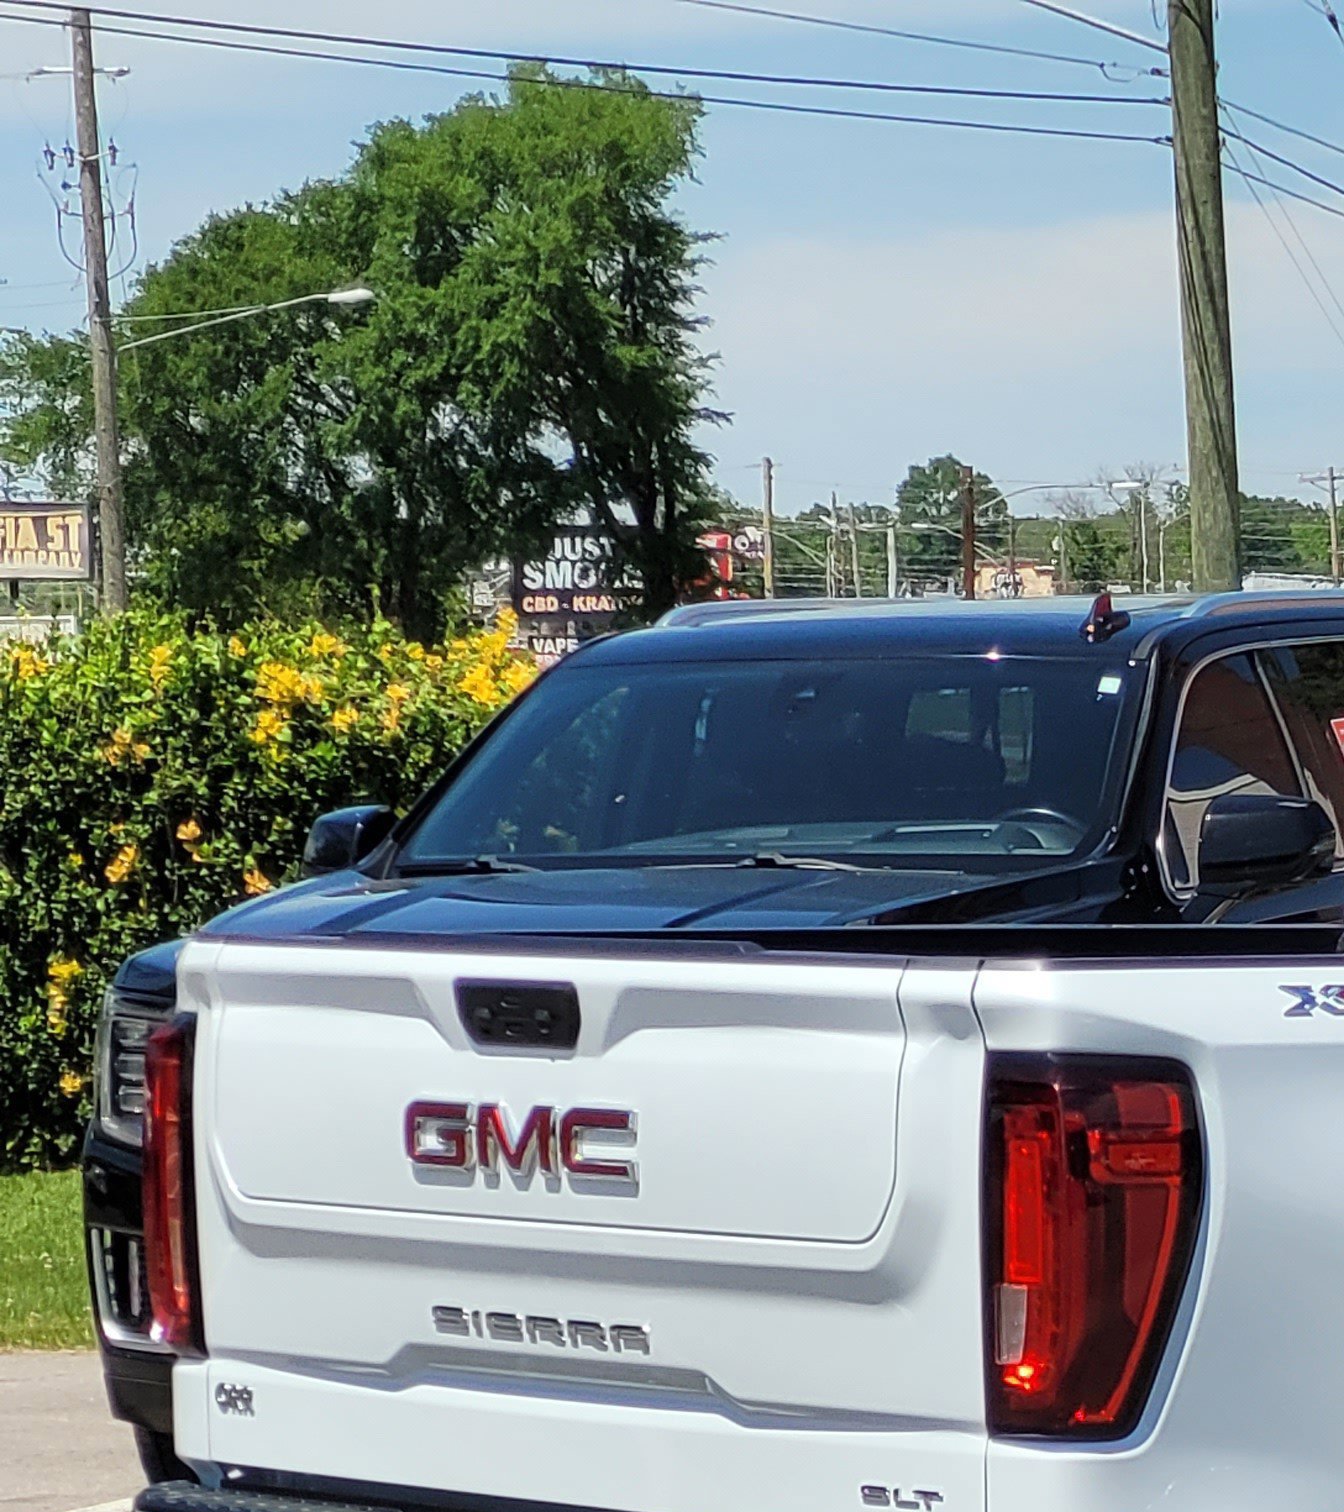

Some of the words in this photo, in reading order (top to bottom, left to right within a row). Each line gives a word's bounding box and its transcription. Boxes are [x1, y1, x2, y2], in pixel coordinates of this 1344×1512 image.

[548, 537, 616, 560] JUST
[522, 596, 559, 612] CBD
[405, 1100, 638, 1180] GMC
[432, 1305, 650, 1350] SIERRA
[860, 1485, 944, 1511] SLT
